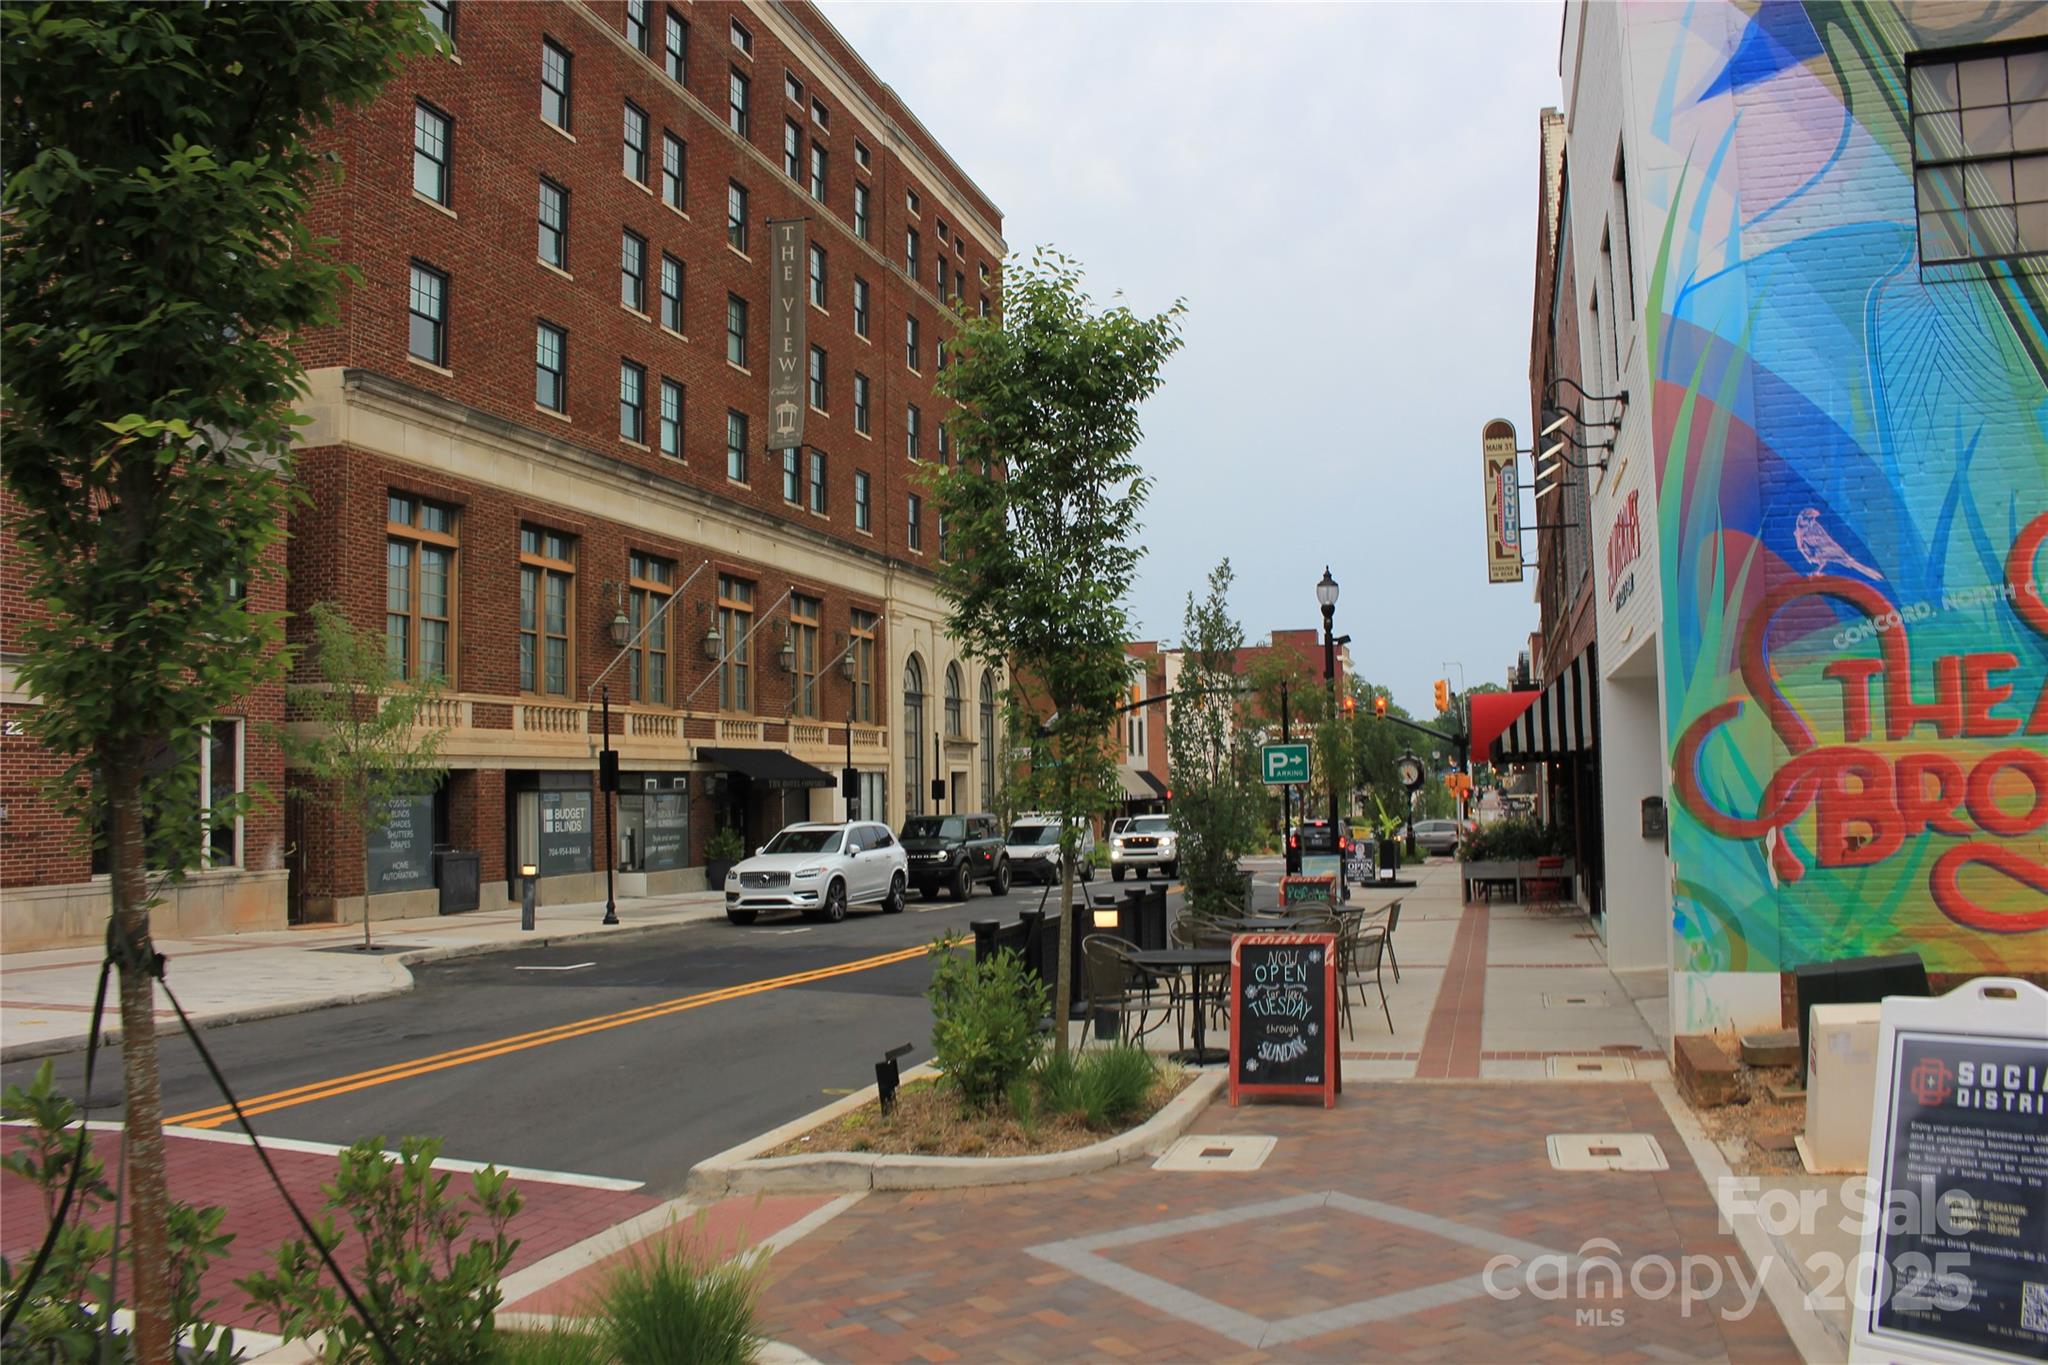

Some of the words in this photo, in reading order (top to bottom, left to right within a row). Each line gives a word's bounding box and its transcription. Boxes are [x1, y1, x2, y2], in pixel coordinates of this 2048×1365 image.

[781, 225, 795, 282] THE
[778, 297, 797, 372] VIEW
[1486, 444, 1503, 452] MAIN
[1504, 472, 1515, 541] DONUTS
[1832, 600, 1937, 650] CONCORD,
[1941, 583, 2016, 611] NORTH
[1823, 652, 2023, 743] THE
[554, 807, 585, 819] BUDGET
[390, 820, 411, 829] SHADES
[554, 820, 582, 833] BLINDS
[387, 830, 414, 839] SHUTTERS
[390, 840, 411, 849] DRAPES
[392, 860, 408, 869] HOME
[1347, 862, 1373, 871] OPEN
[382, 871, 419, 881] AUTOMATION
[1267, 950, 1299, 966] NOW
[1255, 964, 1307, 983] OPEN
[1248, 996, 1312, 1021] TUESDAY
[1266, 1023, 1299, 1038] through
[1933, 1126, 1949, 1134] your
[1986, 1129, 2023, 1141] beverage
[2024, 1134, 2035, 1142] on
[1947, 1238, 1968, 1250] Drink
